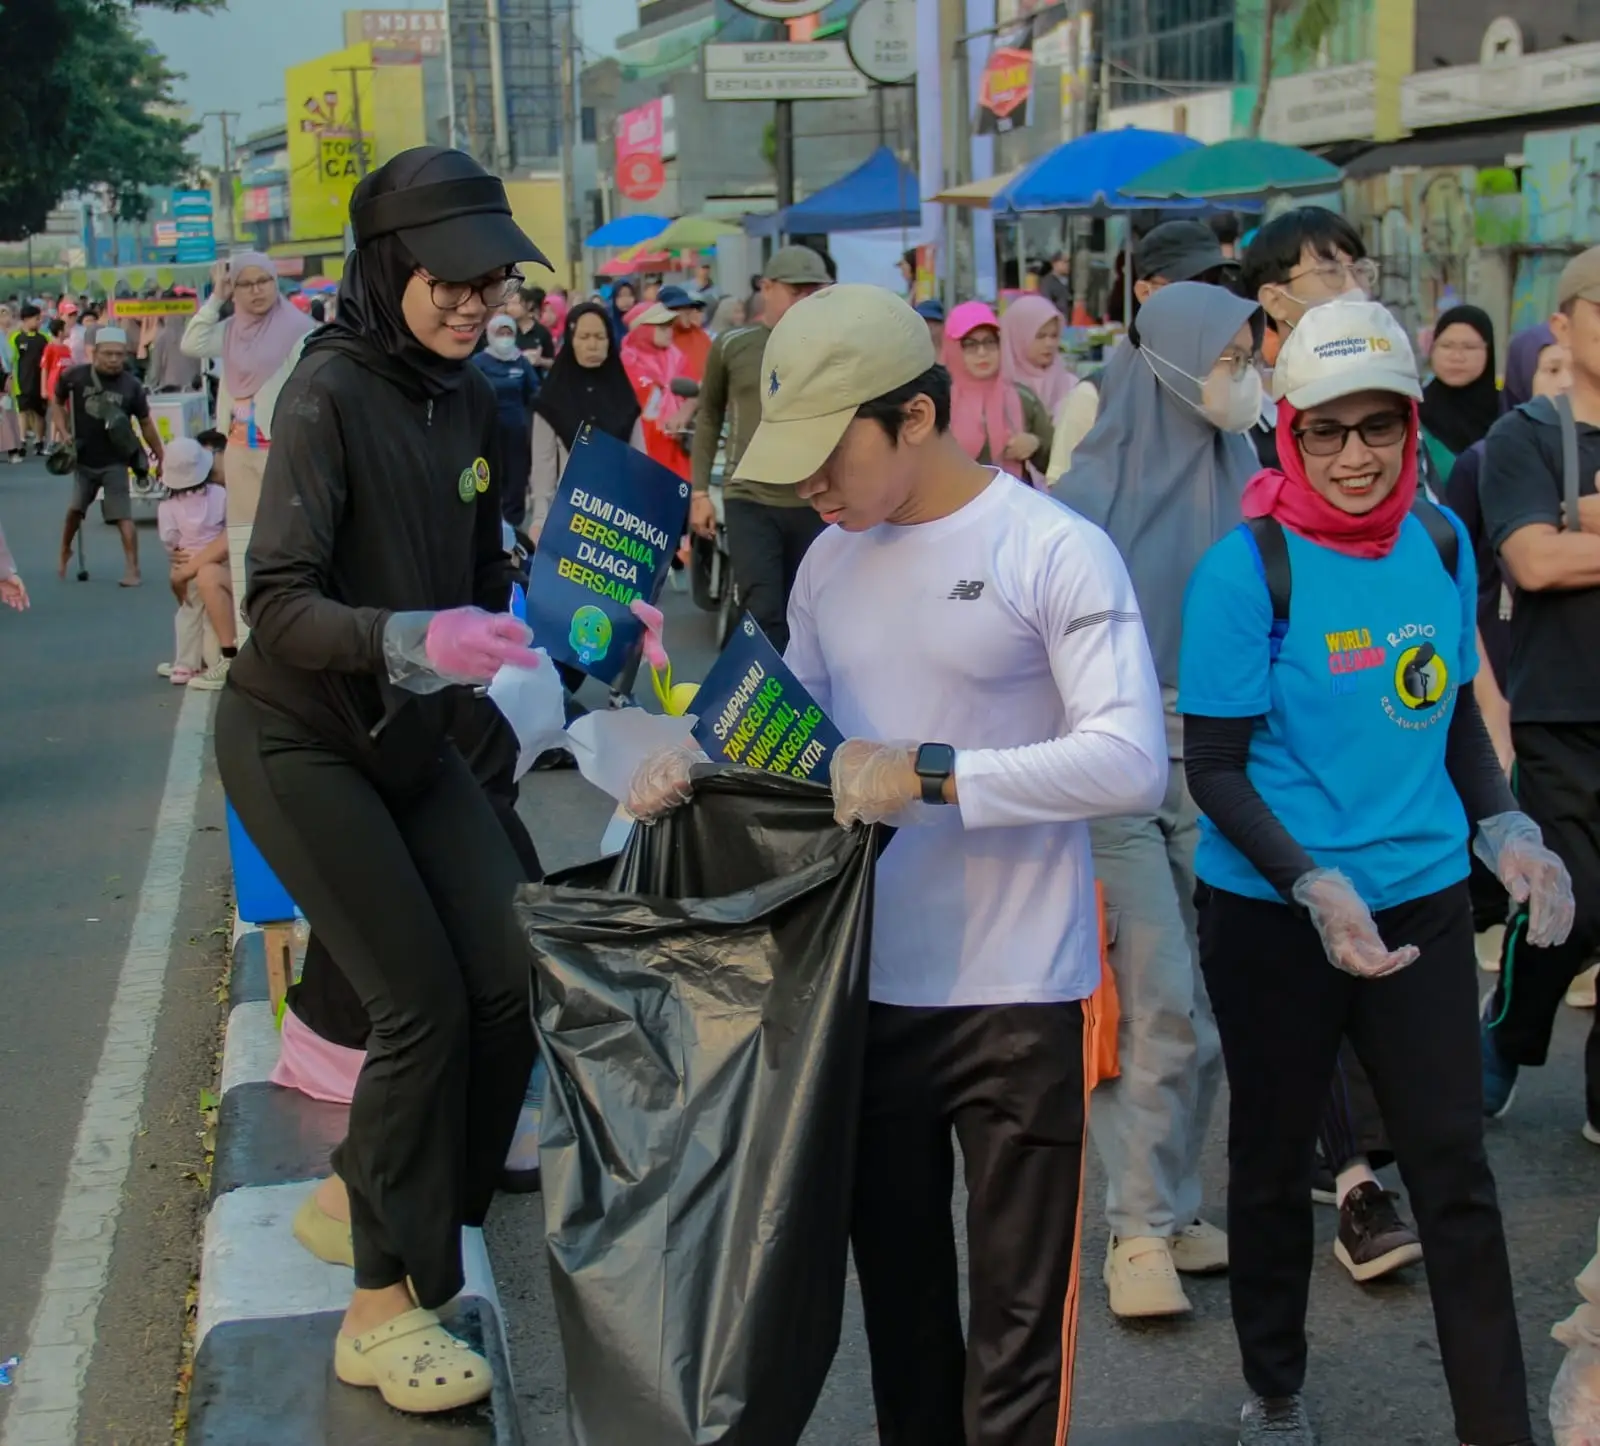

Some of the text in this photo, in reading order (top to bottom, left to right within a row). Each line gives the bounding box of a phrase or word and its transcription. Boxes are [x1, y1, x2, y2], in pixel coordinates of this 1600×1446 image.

[1313, 336, 1367, 354] Kemenkeu
[1319, 344, 1367, 360] Mengajar
[569, 487, 669, 551] BUMI DIPAKAI
[569, 513, 656, 573] BERSAMA,
[576, 541, 638, 584] DIJAGA
[1324, 627, 1372, 654] WORLD
[1386, 623, 1436, 648] RADIO
[713, 659, 765, 740] SAMPAHMU
[722, 677, 784, 762] TANGGUNG
[1381, 696, 1428, 731] RELAWAN
[744, 700, 801, 769] AWABMU,
[798, 738, 827, 775] KITA
